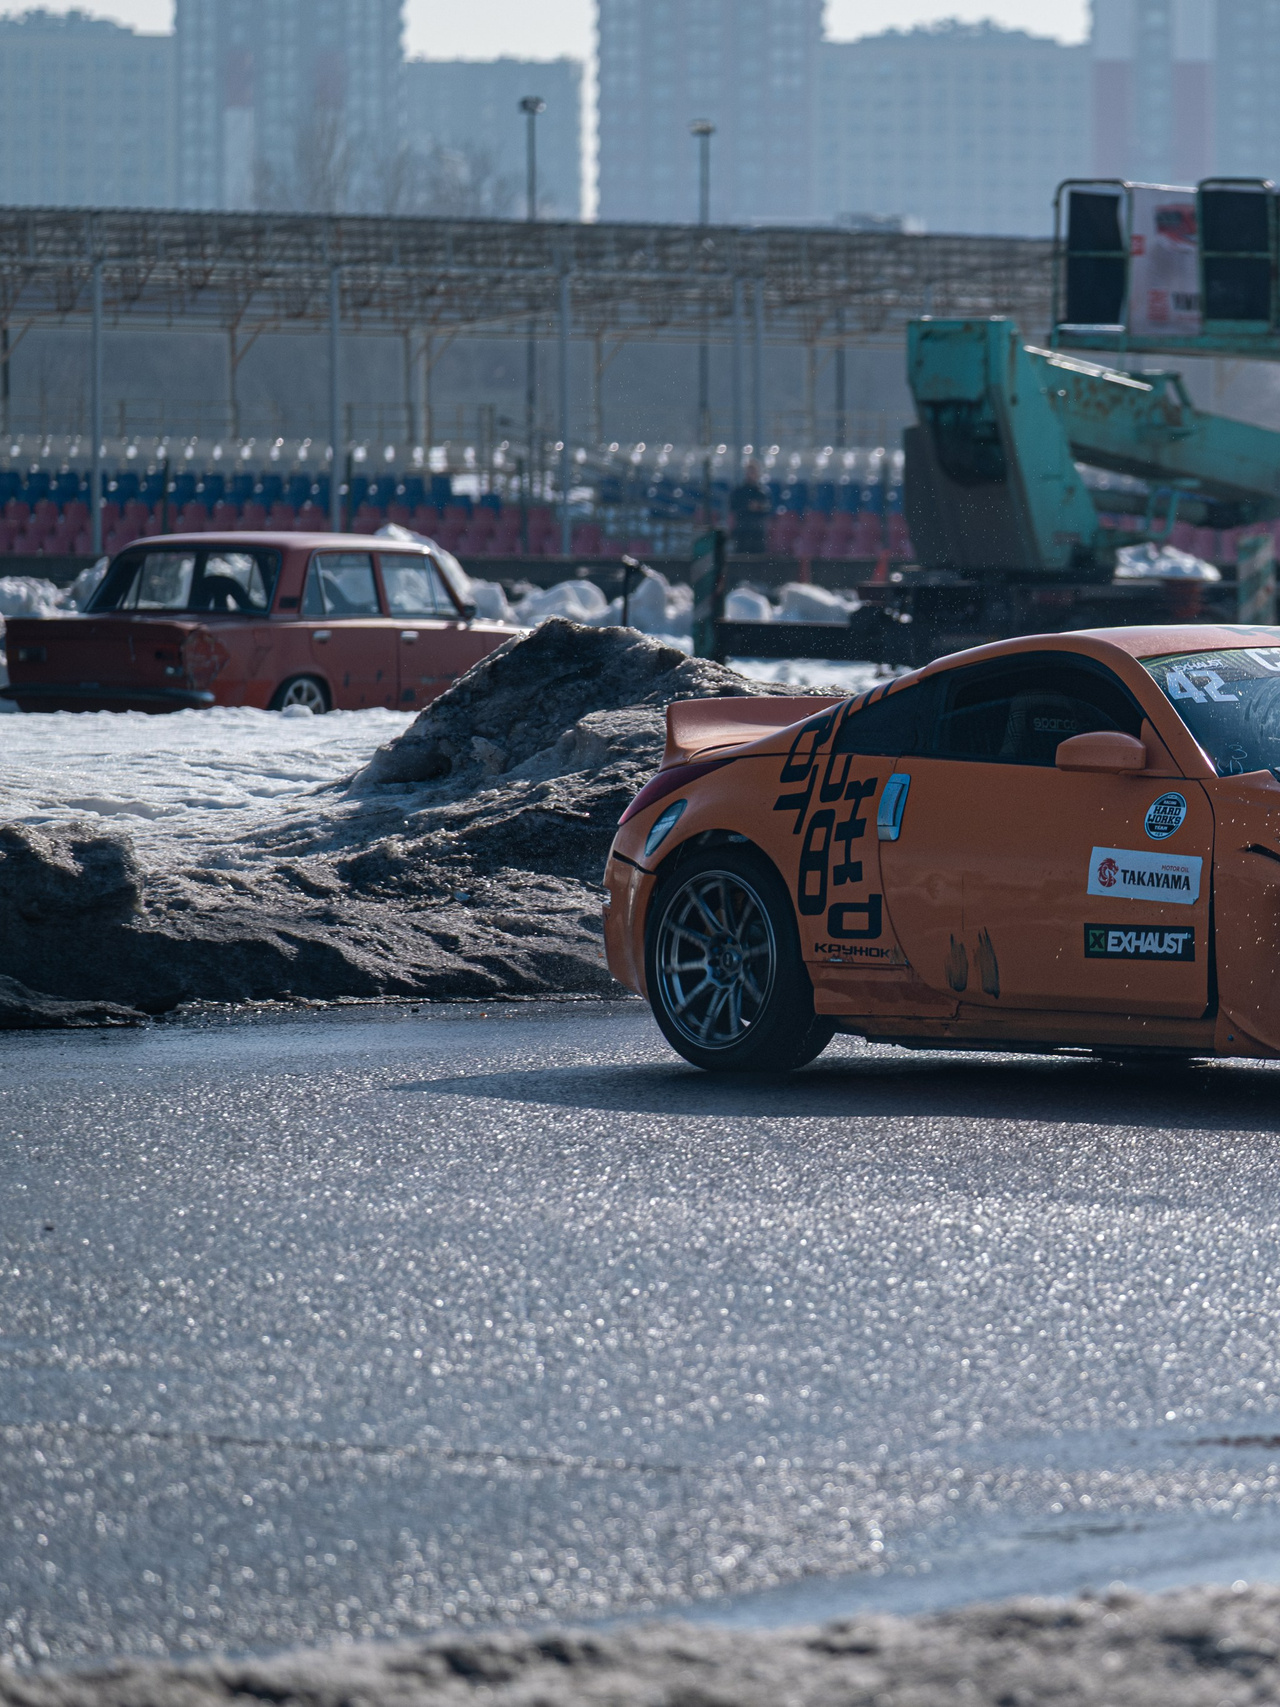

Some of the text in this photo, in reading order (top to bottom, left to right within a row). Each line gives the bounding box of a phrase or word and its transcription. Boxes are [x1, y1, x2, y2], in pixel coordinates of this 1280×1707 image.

[1166, 671, 1239, 703] 42
[1033, 717, 1079, 730] sparco
[1147, 814, 1182, 825] WORKS
[1154, 806, 1181, 816] HARD
[1121, 869, 1191, 890] TAKAYAMA
[1107, 931, 1188, 954] EXHAUST
